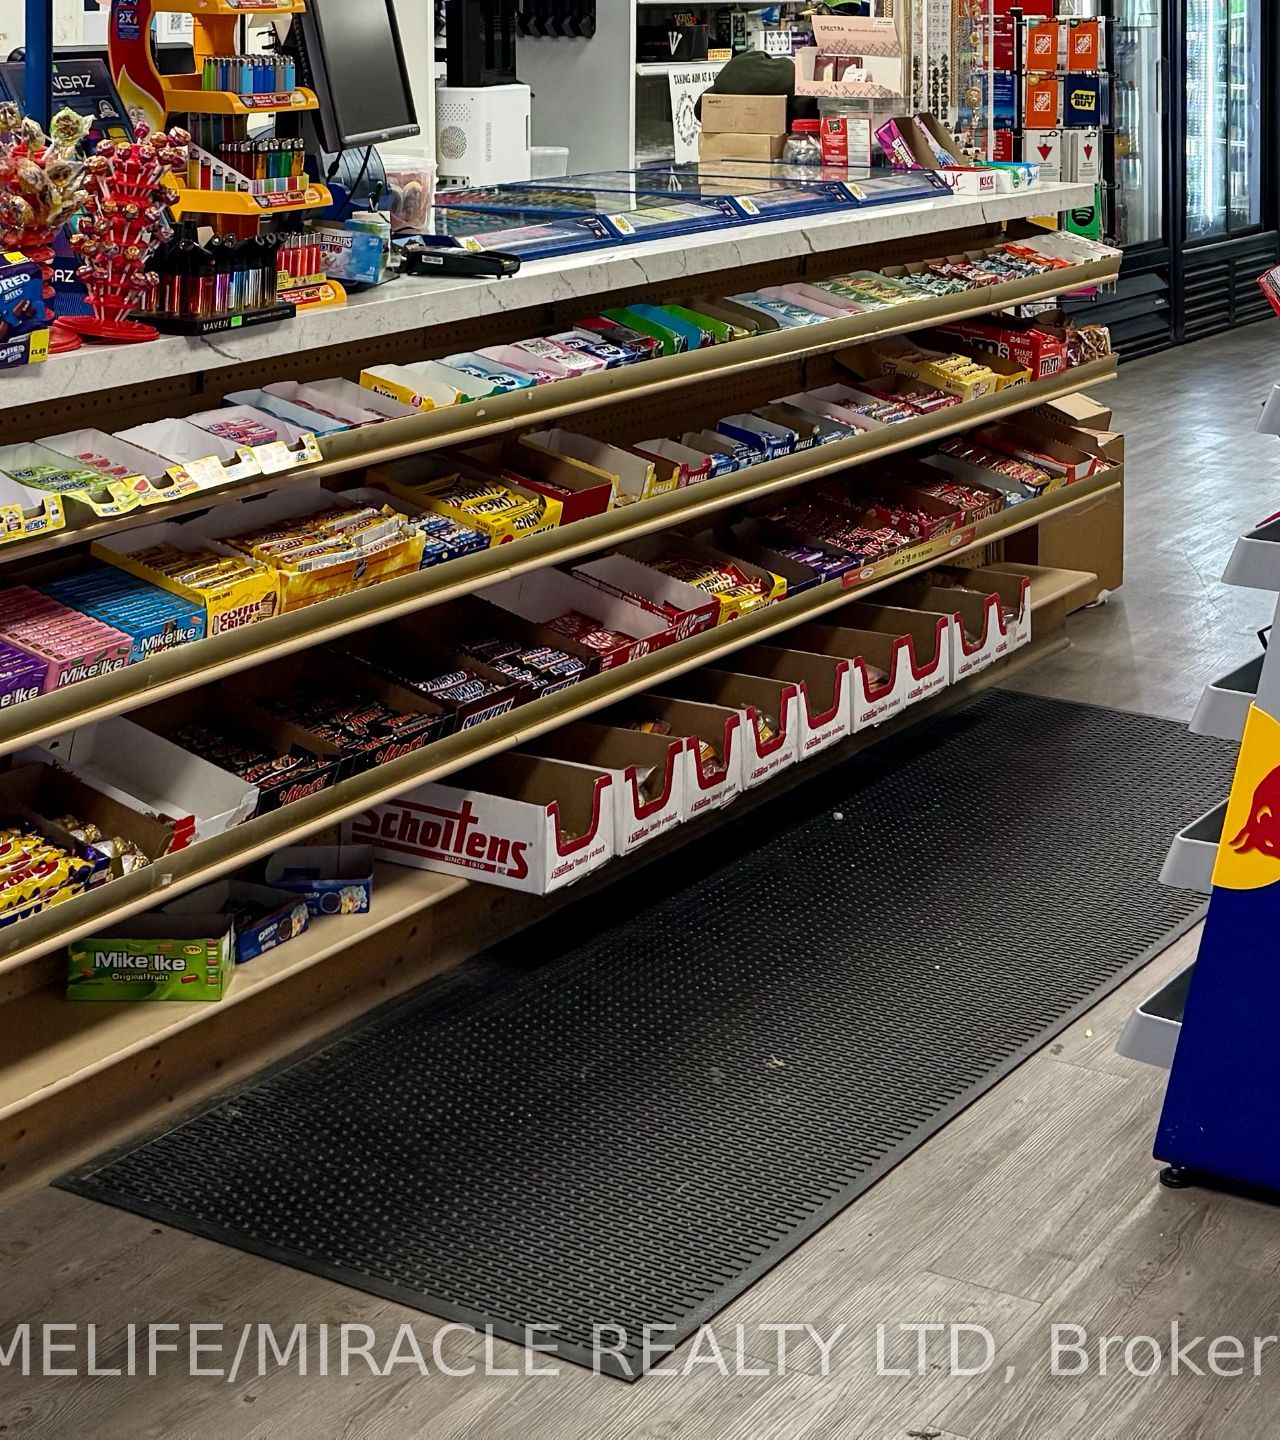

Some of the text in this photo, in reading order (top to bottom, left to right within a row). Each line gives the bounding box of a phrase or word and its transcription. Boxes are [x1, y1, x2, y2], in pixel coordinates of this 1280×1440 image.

[1073, 93, 1095, 102] BEST
[1074, 100, 1093, 108] BUY
[203, 321, 229, 332] MAVEN
[795, 438, 814, 451] HALLS
[688, 472, 708, 485] HALLS
[219, 602, 261, 621] COFFEE
[219, 614, 252, 632] CRISP
[140, 626, 196, 653] Mike Ike
[58, 657, 124, 687] Mike Ike
[14, 685, 40, 703] Ike
[352, 800, 529, 880] Scholtens
[95, 951, 186, 972] Mike Ike
[112, 972, 147, 982] Original
